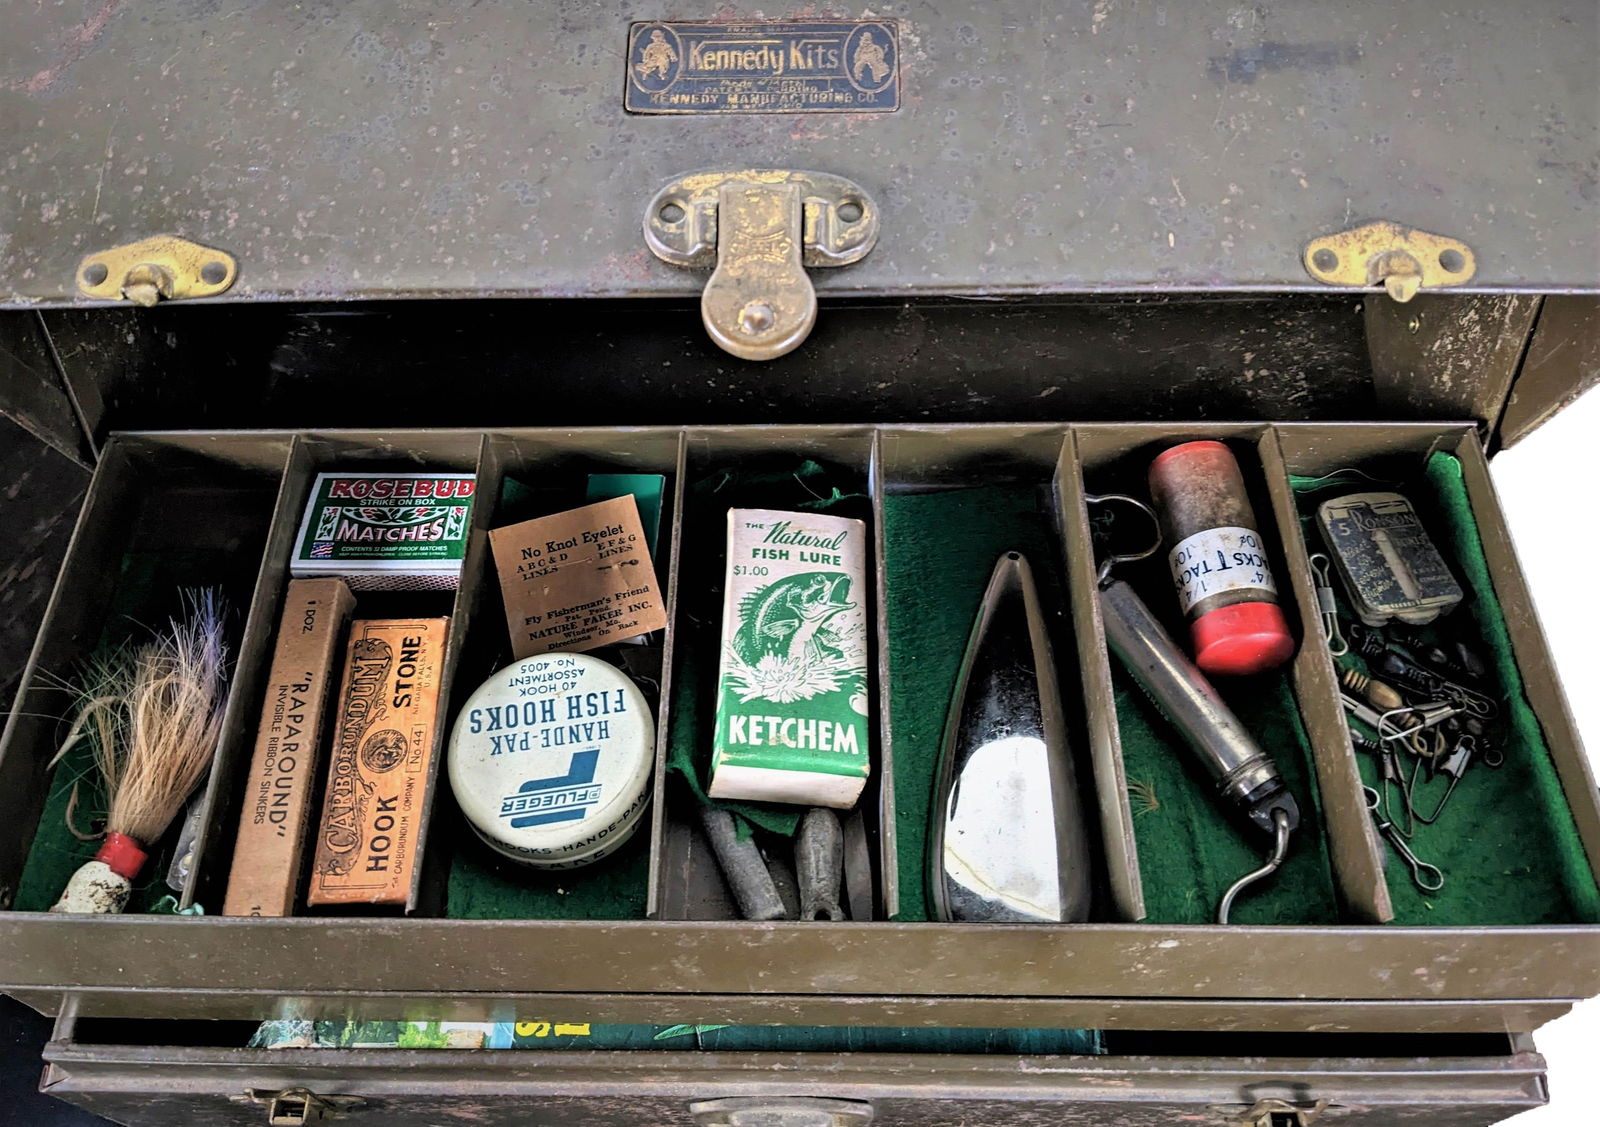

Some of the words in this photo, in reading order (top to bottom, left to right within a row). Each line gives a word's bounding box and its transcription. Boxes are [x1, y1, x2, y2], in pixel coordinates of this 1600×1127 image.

[688, 40, 785, 75] Kennedy
[789, 40, 840, 70] Kits
[650, 93, 718, 105] KENNEDY
[727, 93, 854, 104] MANUFACTURING
[327, 479, 475, 500] ROSEBUD
[414, 498, 436, 506] BOX
[335, 517, 446, 542] MATCHES
[608, 540, 615, 548] F
[628, 534, 637, 542] G
[745, 522, 765, 530] THE
[763, 520, 848, 551] Natural
[1338, 522, 1351, 536] 5
[522, 547, 541, 560] No
[545, 537, 578, 554] Knot
[582, 524, 624, 543] Eyelet
[598, 544, 633, 560] LINES
[516, 565, 525, 574] A
[528, 561, 536, 571] B
[538, 558, 546, 567] C
[560, 553, 568, 562] D
[752, 548, 790, 561] FISH
[799, 551, 842, 566] LURE
[1233, 552, 1269, 571] ACKS
[522, 566, 559, 581] LINES
[733, 565, 769, 577] $1.00
[525, 614, 542, 626] Fly
[547, 595, 612, 620] Fisherman's
[615, 585, 650, 601] Friend
[529, 621, 578, 641] NATURE
[583, 609, 624, 627] FAKER
[629, 601, 653, 613] INC.
[548, 634, 592, 650] Directions
[598, 629, 610, 637] On
[618, 620, 639, 631] Back
[520, 662, 550, 674] 4005
[554, 658, 575, 667] No.
[508, 668, 586, 688] ASSORTMENT
[519, 684, 557, 697] HOOK
[562, 681, 577, 691] 40
[271, 684, 289, 733] INVISIBLE
[412, 681, 422, 715] NIGARA
[566, 688, 627, 719] FISH
[470, 698, 556, 734] HOOKS
[414, 729, 424, 748] 44
[490, 720, 610, 756] HANDE-PAK
[728, 714, 860, 755] KETCHEM
[263, 736, 280, 777] RIBBON
[325, 655, 391, 855] CARBORUNDUM
[365, 794, 399, 873] HOOK
[392, 636, 422, 709] STONE
[253, 779, 271, 825] SINKERS
[501, 787, 602, 813] PFLUEGER
[394, 816, 409, 875] CARBORUNDUM
[403, 776, 416, 812] COMPANY
